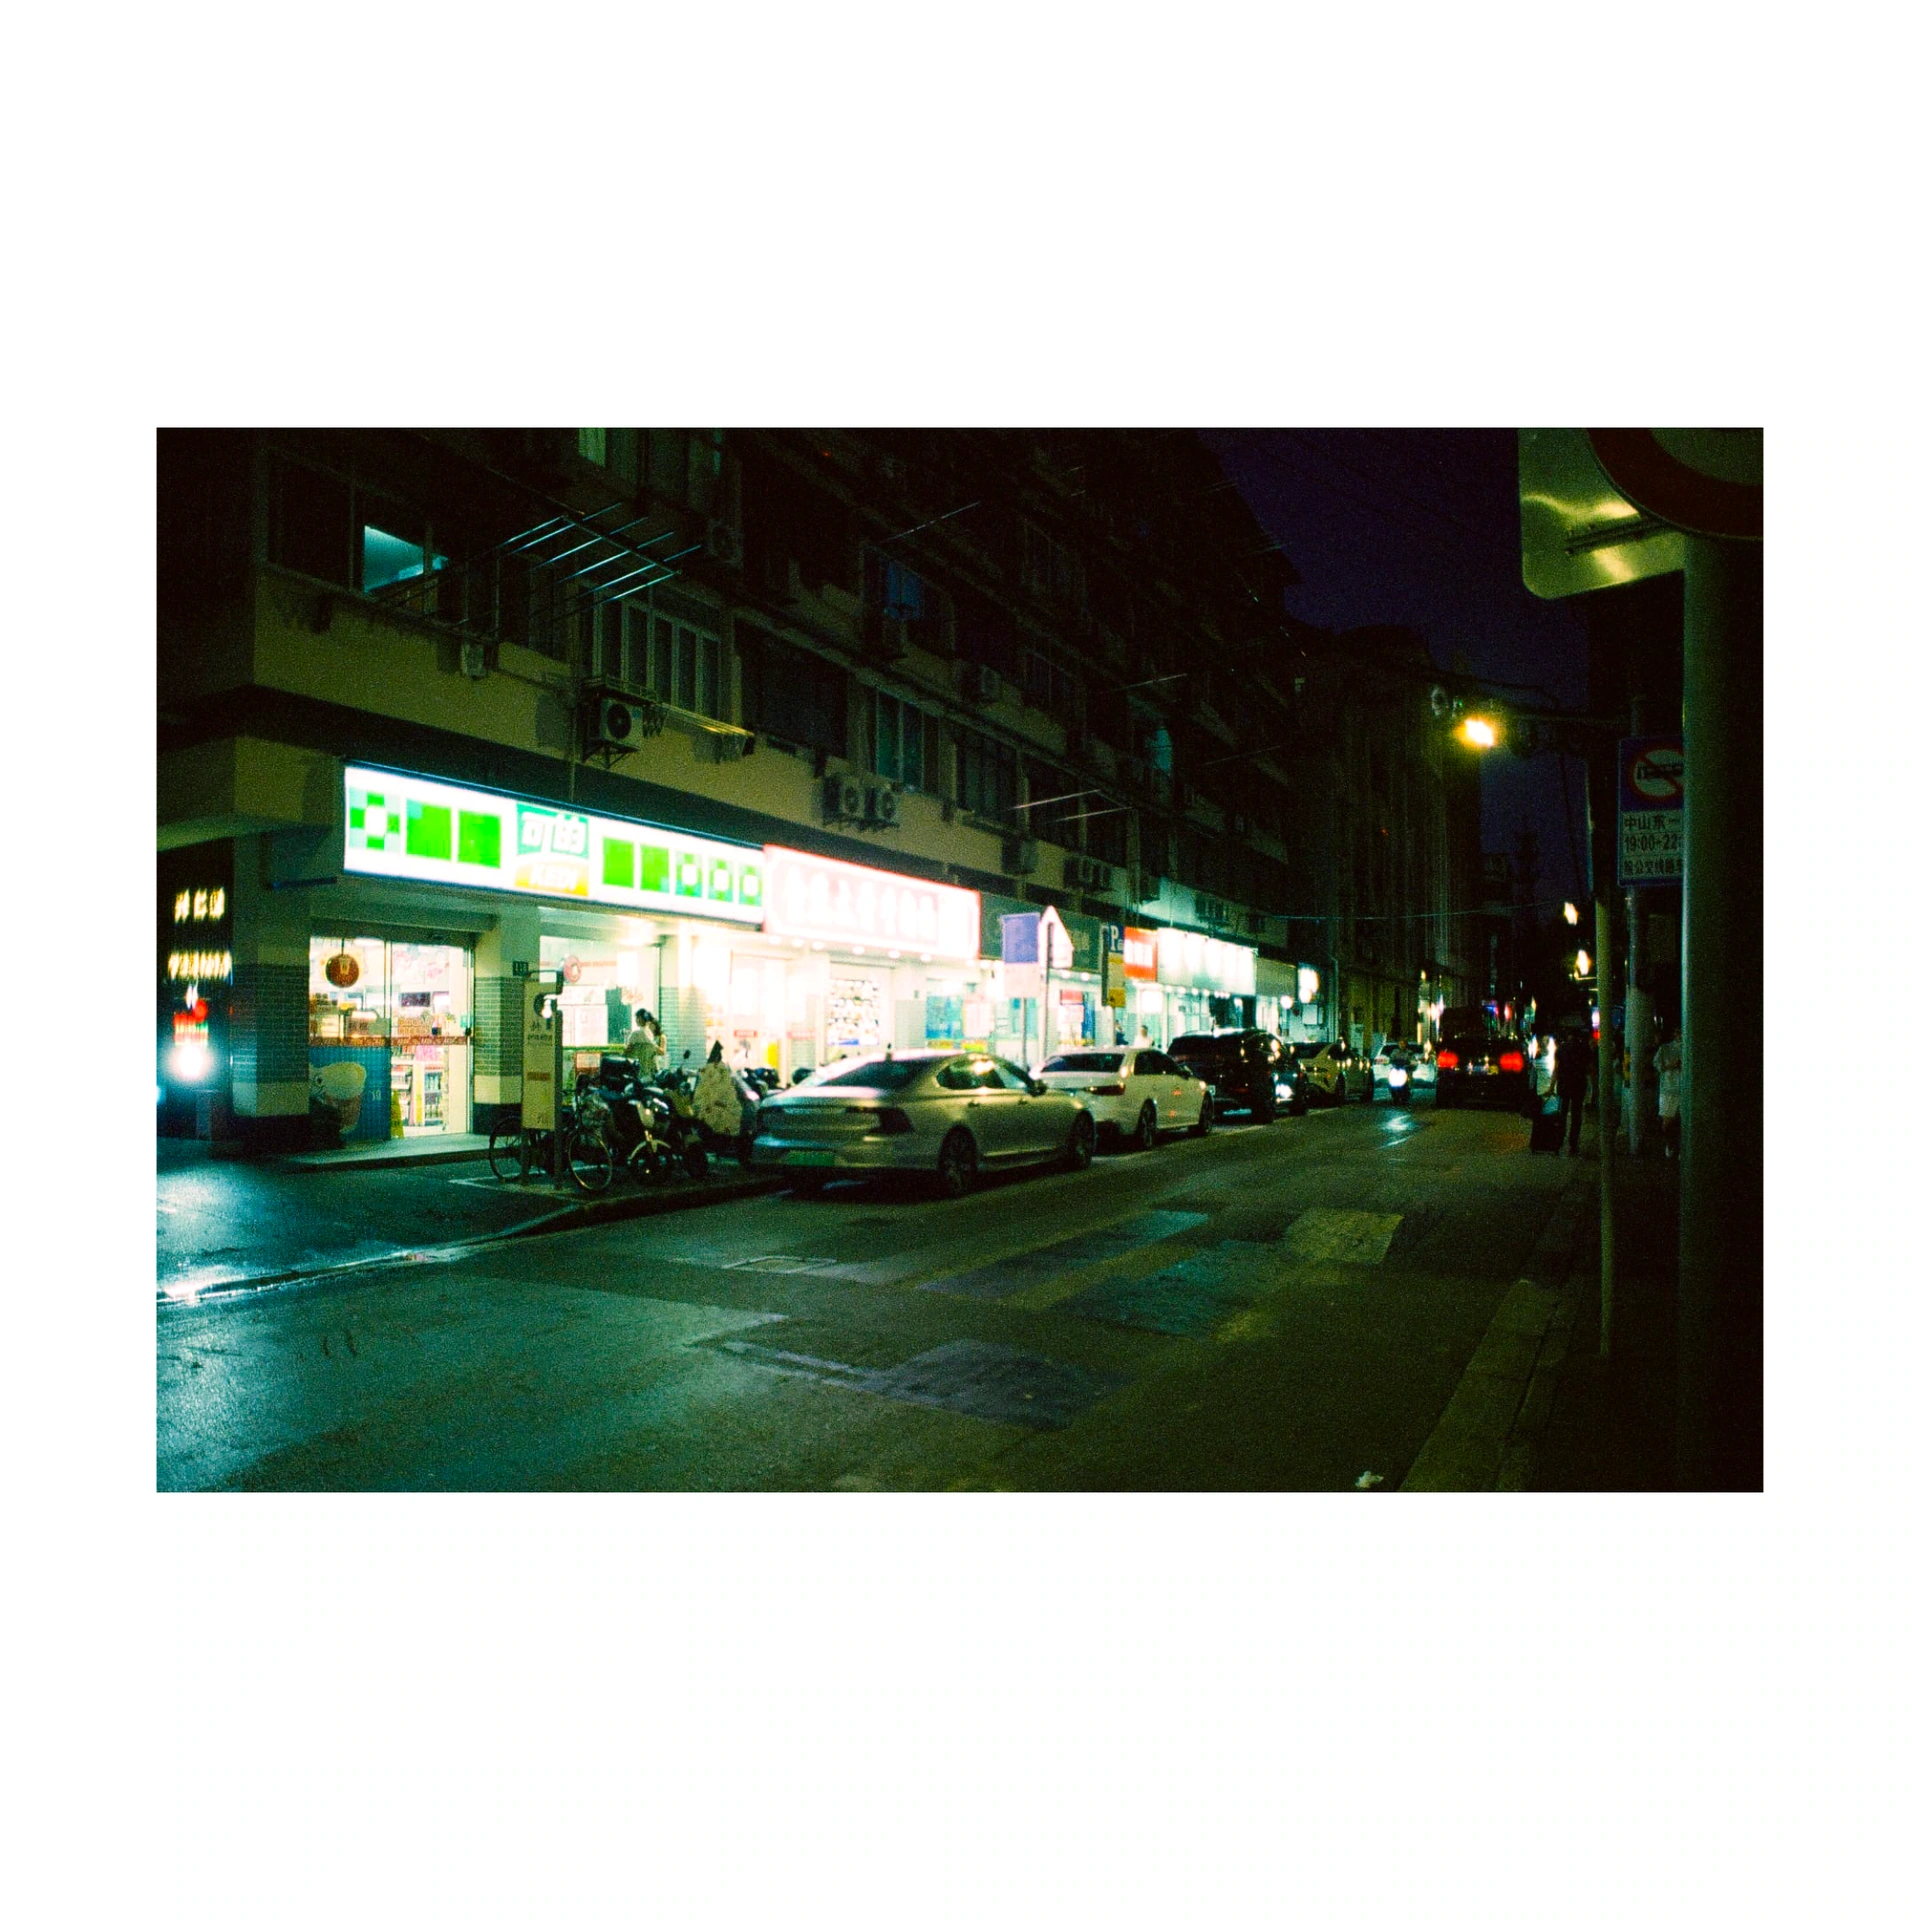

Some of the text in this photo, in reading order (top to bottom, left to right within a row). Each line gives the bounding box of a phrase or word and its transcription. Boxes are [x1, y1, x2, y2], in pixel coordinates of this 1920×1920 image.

[522, 812, 586, 853] 可的
[1624, 814, 1681, 831] 中山东一
[530, 865, 579, 889] KEDI
